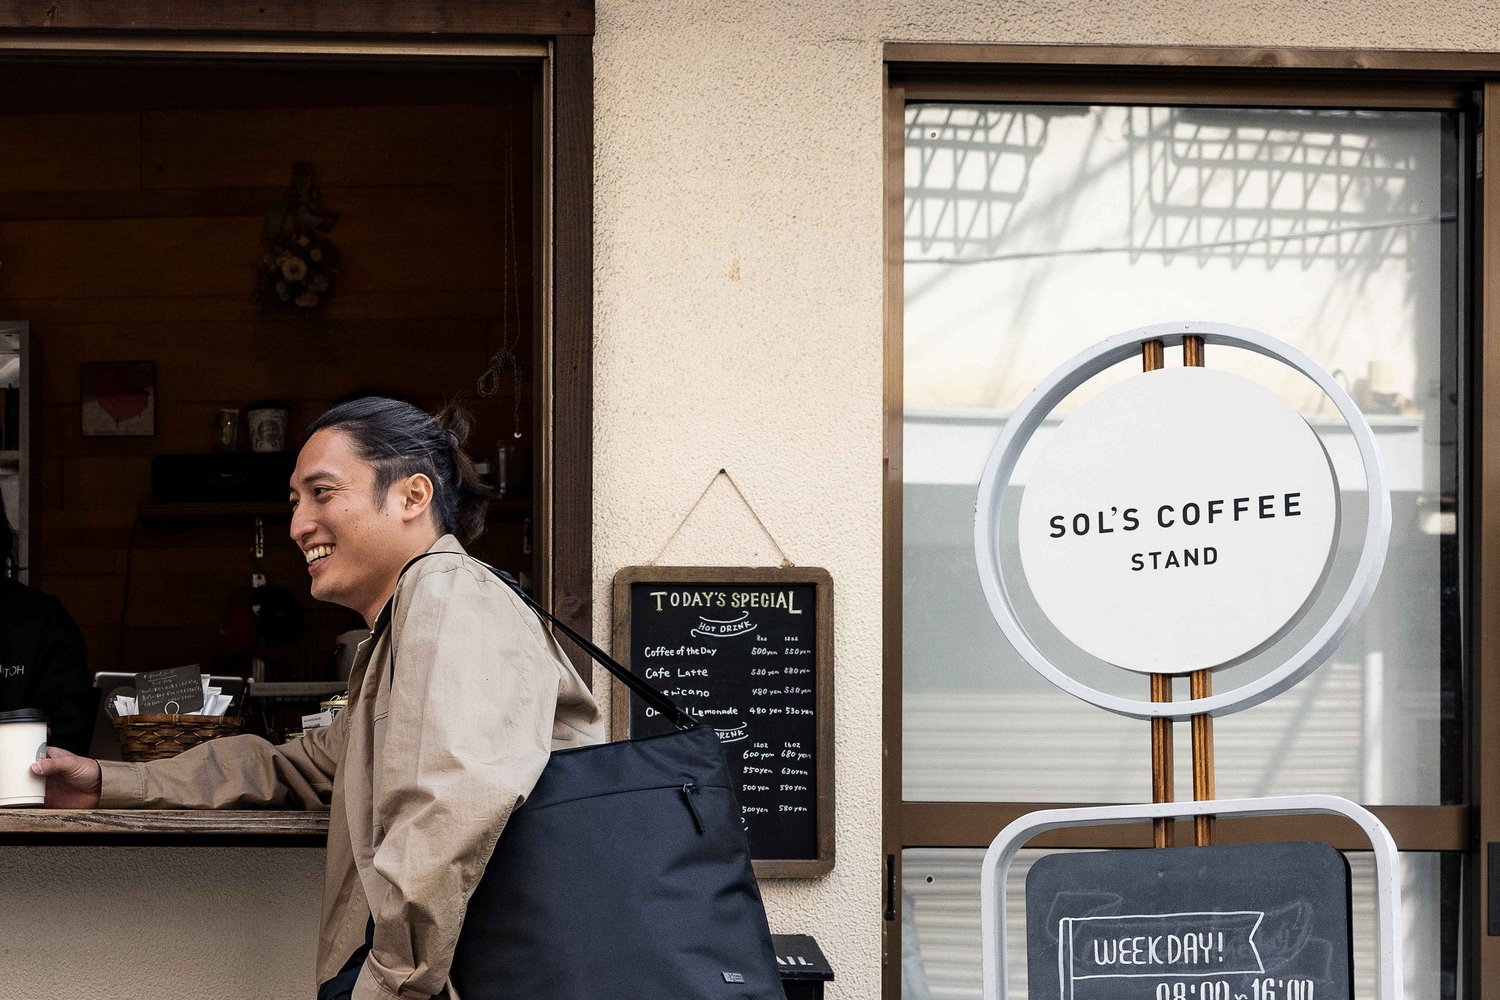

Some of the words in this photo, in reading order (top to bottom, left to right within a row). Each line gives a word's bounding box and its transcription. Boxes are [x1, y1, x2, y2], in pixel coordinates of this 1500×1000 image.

[1049, 506, 1140, 538] SOL'S
[1157, 492, 1301, 528] COFFEE
[1131, 546, 1218, 571] STAND
[650, 591, 726, 611] TODAY'S
[730, 590, 802, 614] SPECIAL
[698, 621, 716, 632] HOT
[720, 620, 752, 633] DRINK
[644, 646, 675, 658] Coffee
[676, 645, 686, 656] of
[686, 646, 700, 656] the
[700, 646, 717, 657] Day
[645, 667, 671, 679] Cafe
[677, 668, 709, 677] Latte
[660, 687, 710, 698] ericano
[691, 706, 739, 717] Lemonade
[715, 729, 745, 740] RINK
[1093, 931, 1224, 966] WEEKDAY!
[775, 955, 814, 966] AIL
